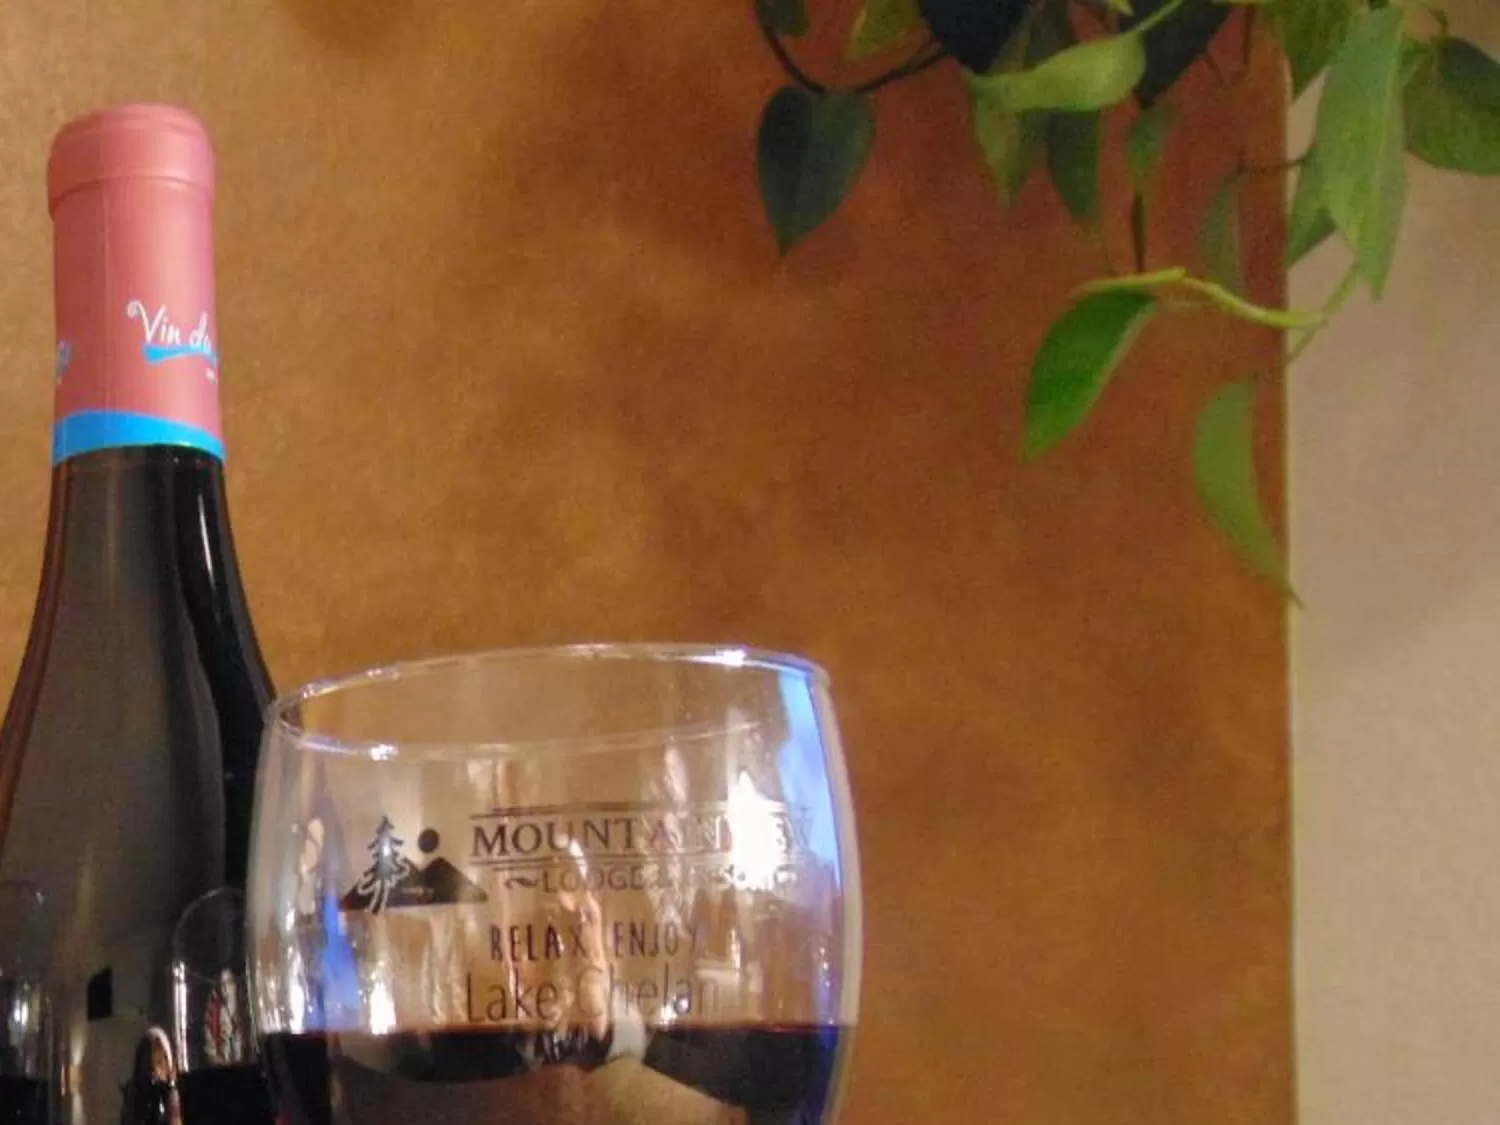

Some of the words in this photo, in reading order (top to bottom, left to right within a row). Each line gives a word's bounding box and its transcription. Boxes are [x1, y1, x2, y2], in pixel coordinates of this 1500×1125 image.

[126, 300, 182, 345] Vin
[471, 818, 724, 858] MOUNTAN
[489, 922, 588, 962] RELAX
[612, 918, 699, 958] ENJOY
[466, 968, 557, 1023] Lake
[577, 962, 719, 1019] Chelan
